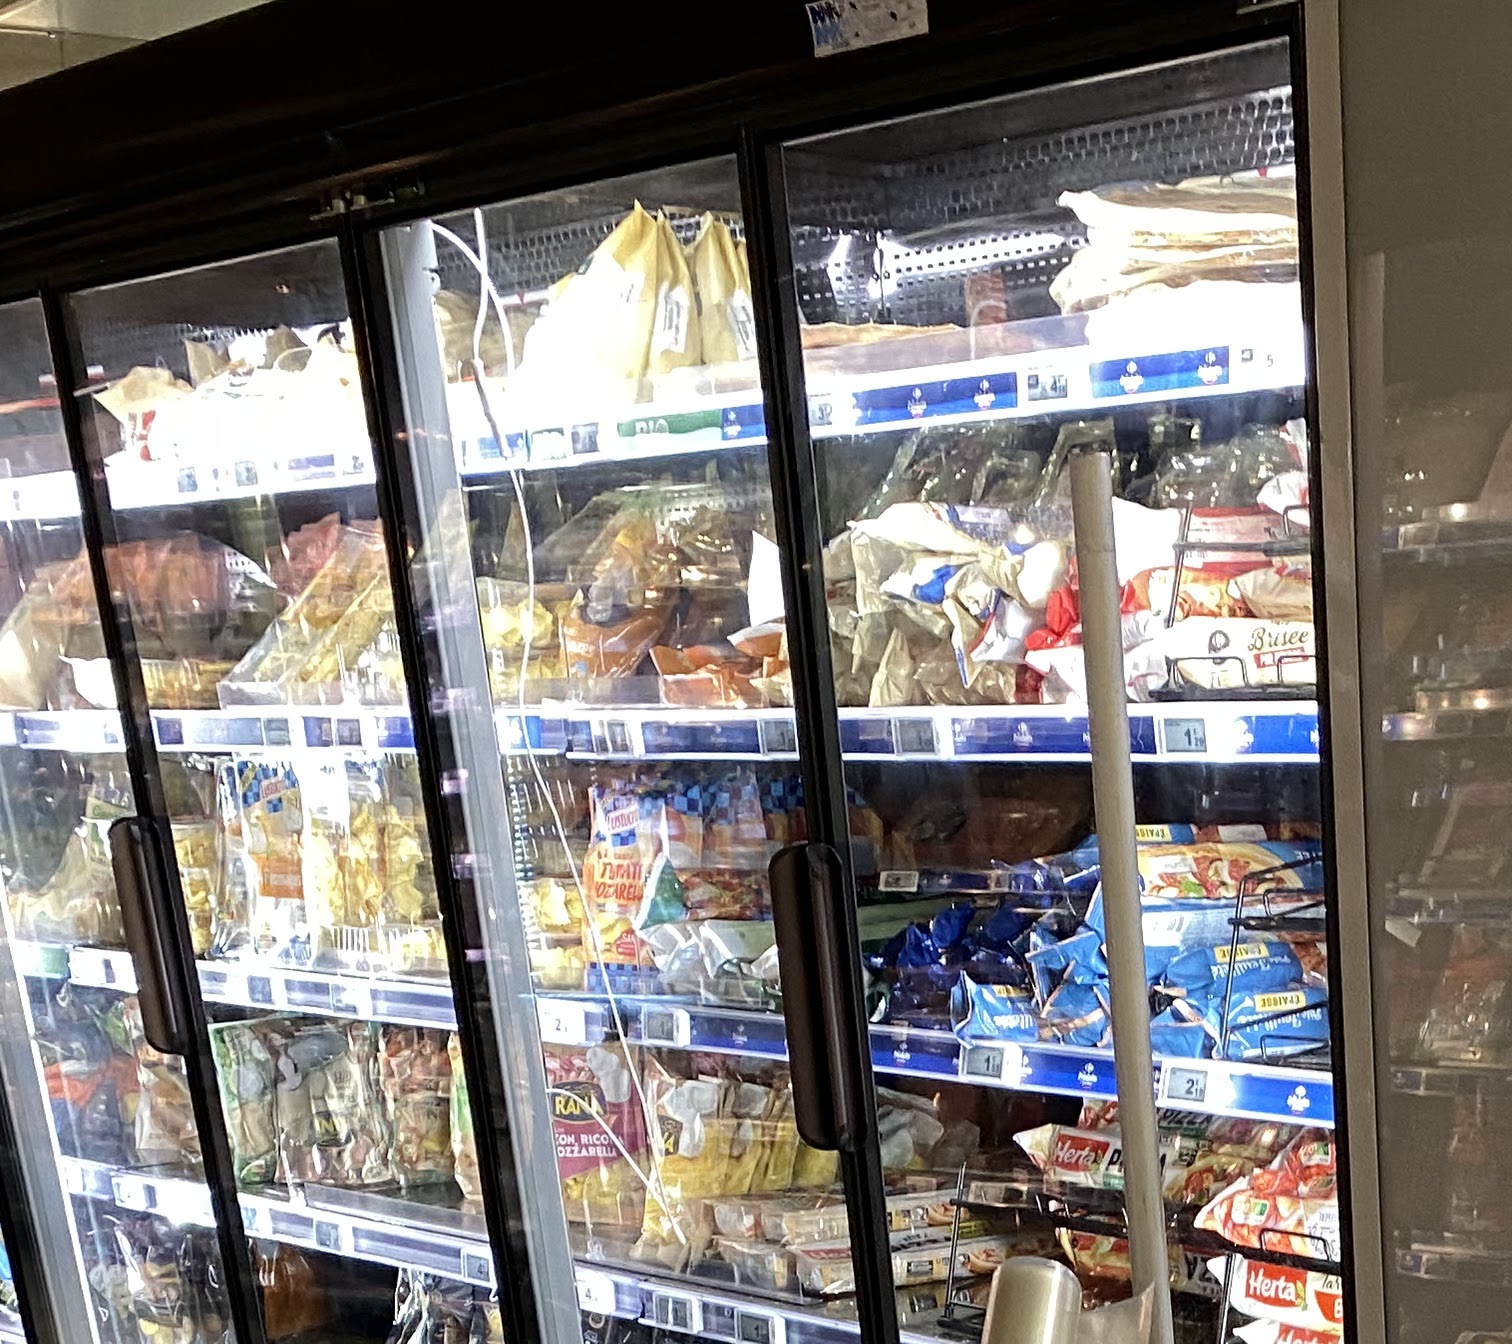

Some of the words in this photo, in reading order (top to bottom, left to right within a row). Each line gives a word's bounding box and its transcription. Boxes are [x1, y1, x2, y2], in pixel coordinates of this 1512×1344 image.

[555, 1095, 605, 1115] RANA
[1054, 1140, 1096, 1165] Herta
[1250, 1268, 1297, 1301] Herta
